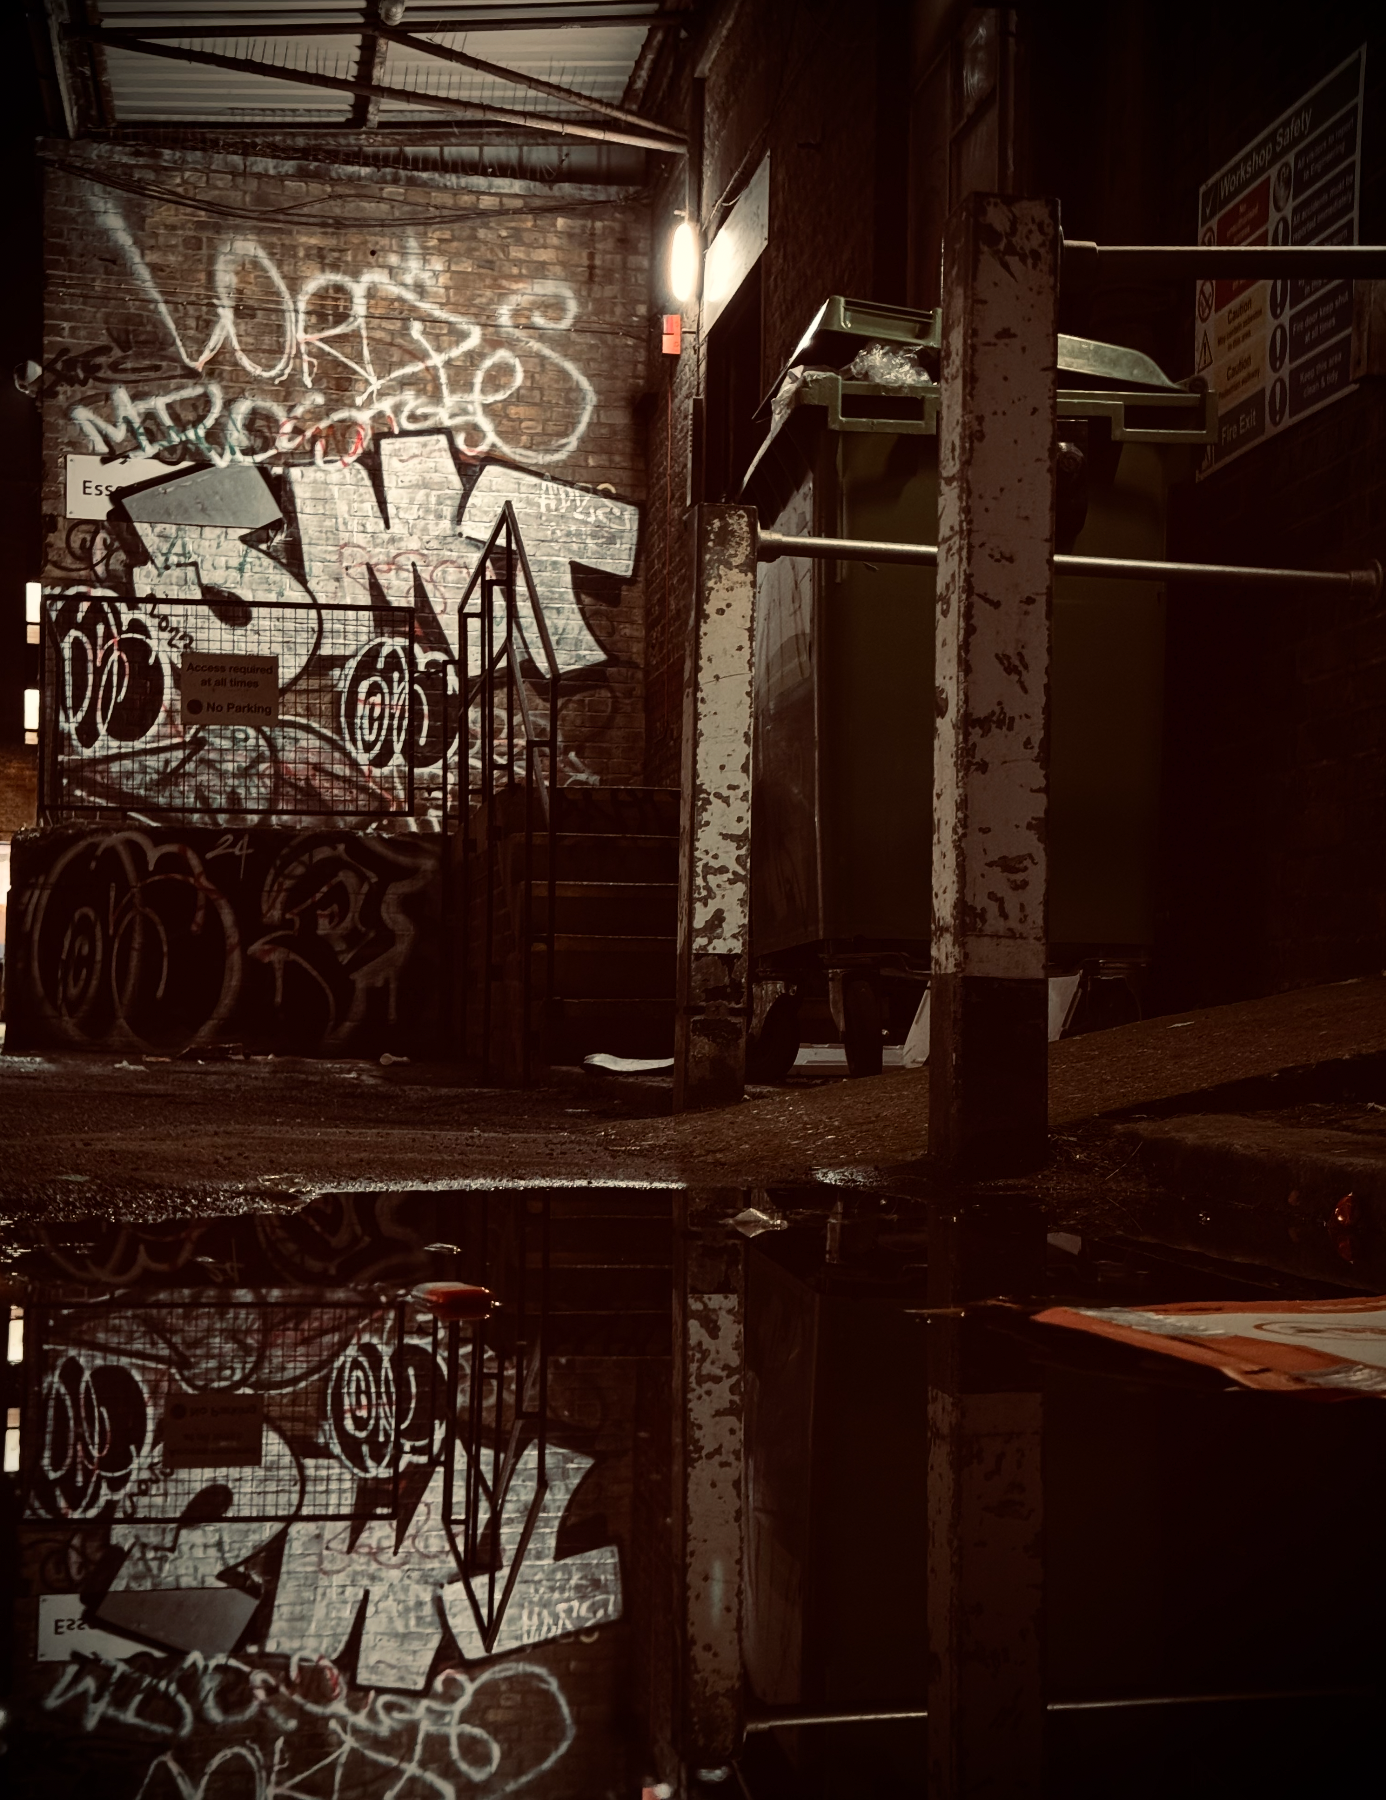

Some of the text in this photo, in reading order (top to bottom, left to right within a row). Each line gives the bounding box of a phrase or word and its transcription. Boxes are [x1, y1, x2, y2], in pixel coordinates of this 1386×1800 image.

[1220, 107, 1313, 200] Workshop Safety
[1227, 298, 1252, 325] Caution
[1304, 310, 1319, 328] door
[1319, 301, 1334, 318] keep
[1334, 290, 1349, 309] shut
[1226, 354, 1252, 382] Caution
[1300, 367, 1315, 384] Keep
[1221, 407, 1257, 447] Fire Exit
[186, 662, 274, 676] Access required
[200, 677, 260, 689] at all times
[206, 702, 273, 717] No Parking
[205, 833, 255, 881] 24
